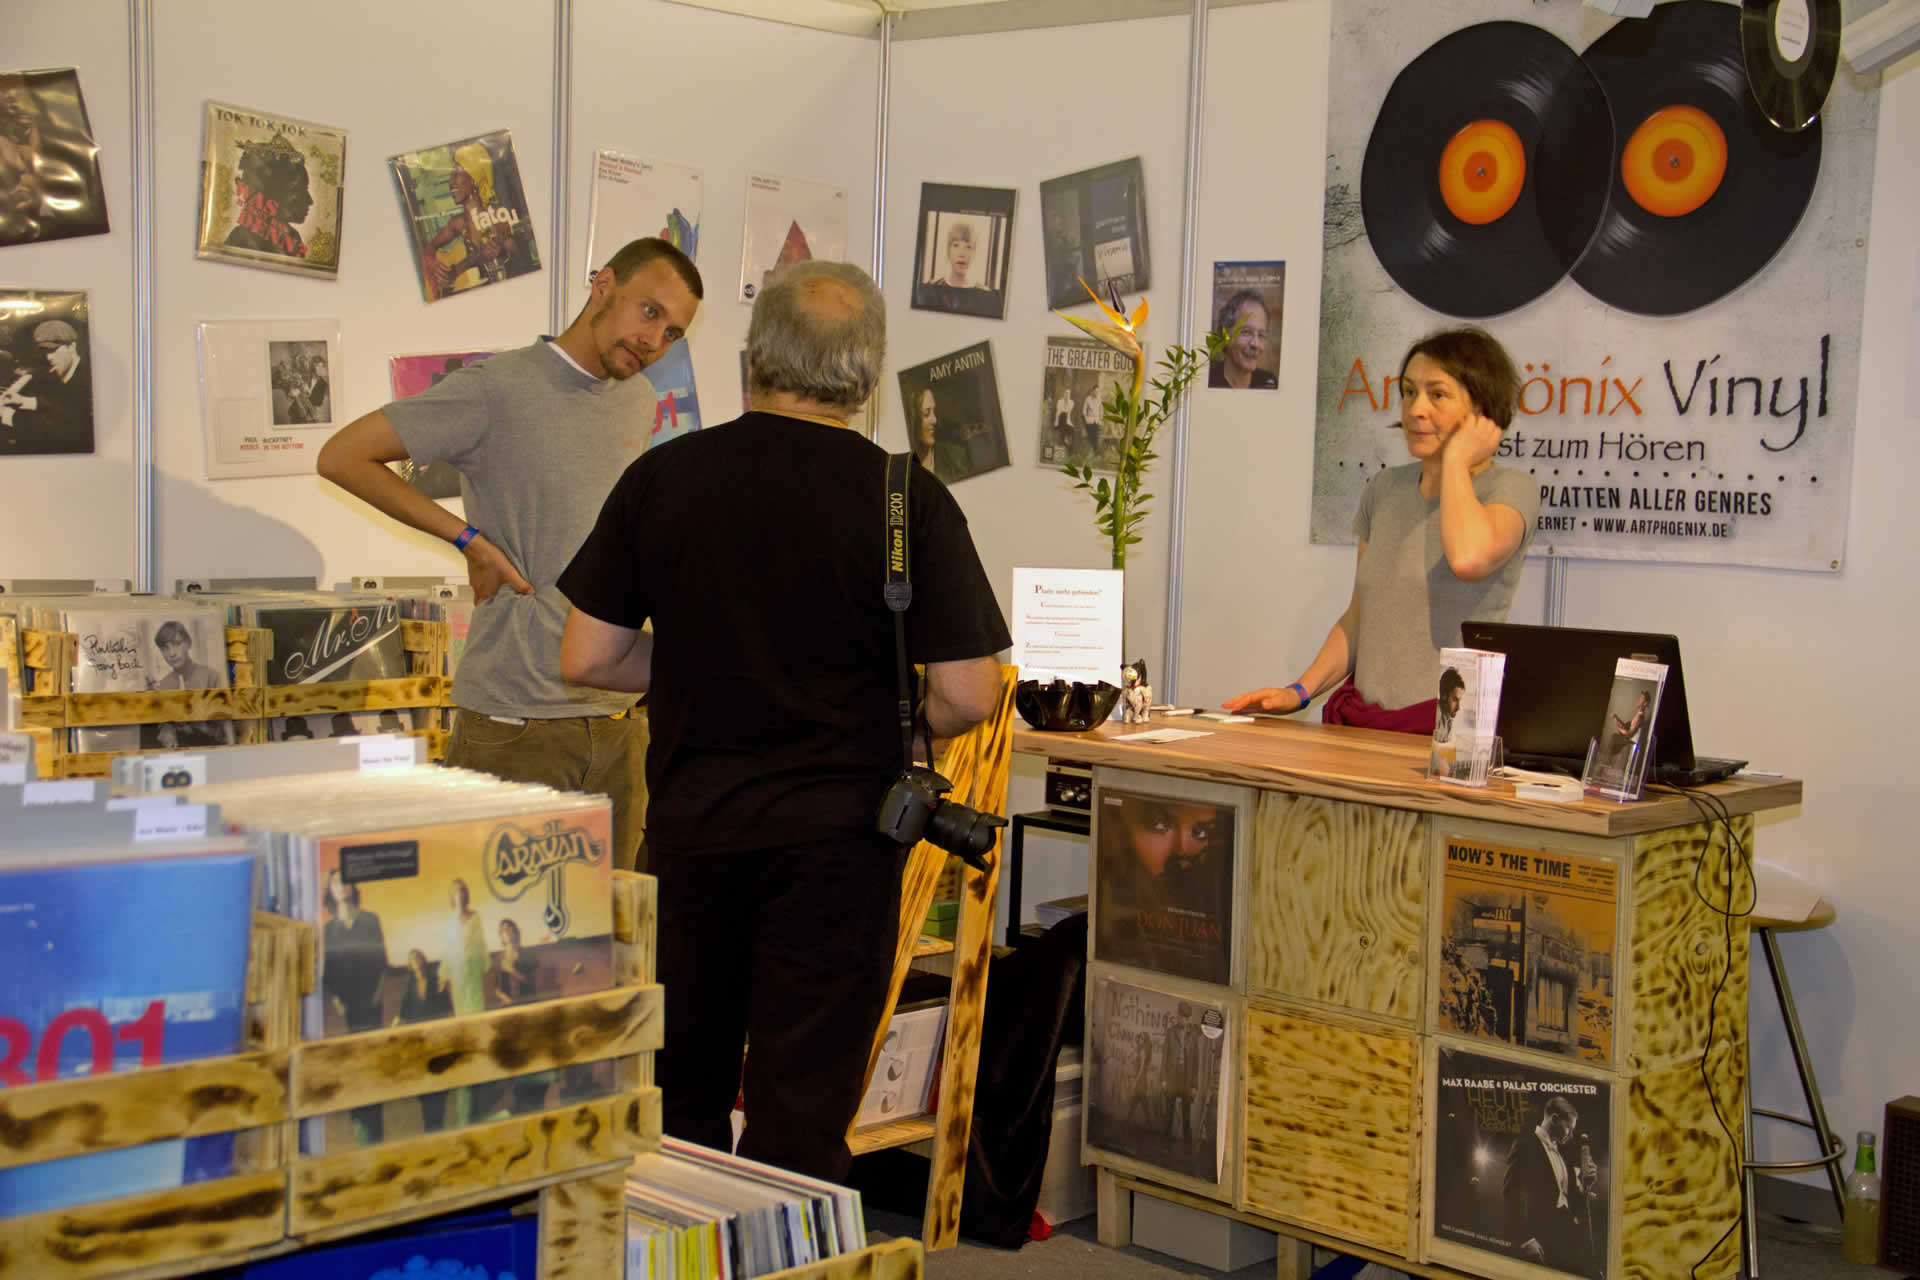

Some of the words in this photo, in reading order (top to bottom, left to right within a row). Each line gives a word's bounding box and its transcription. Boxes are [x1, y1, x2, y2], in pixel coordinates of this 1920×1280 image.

[216, 109, 242, 121] TOK
[249, 116, 276, 130] TOK
[281, 123, 307, 137] TOK
[930, 362, 954, 382] AMY
[953, 350, 985, 371] ANTIN
[1048, 347, 1064, 366] THE
[1066, 349, 1109, 369] GREATER
[1663, 334, 1831, 452] Vinyl
[1531, 437, 1589, 459] zum
[1598, 430, 1705, 461] Hören
[890, 492, 904, 526] D200
[1629, 488, 1687, 512] ALLER
[1694, 491, 1772, 515] GENRES
[1537, 516, 1577, 531] ERNET
[1593, 517, 1729, 539] WWW.ARTPHOENIX.DE
[891, 529, 904, 572] Nikon
[285, 611, 350, 679] Mr.
[1448, 844, 1494, 867] NOW'S
[1500, 852, 1528, 872] THE
[1534, 857, 1572, 879] TIME
[1442, 1078, 1463, 1087] MAX
[1464, 1079, 1495, 1089] RAABE
[1503, 1081, 1537, 1092] PALAST
[1539, 1082, 1597, 1095] ORCHESTER
